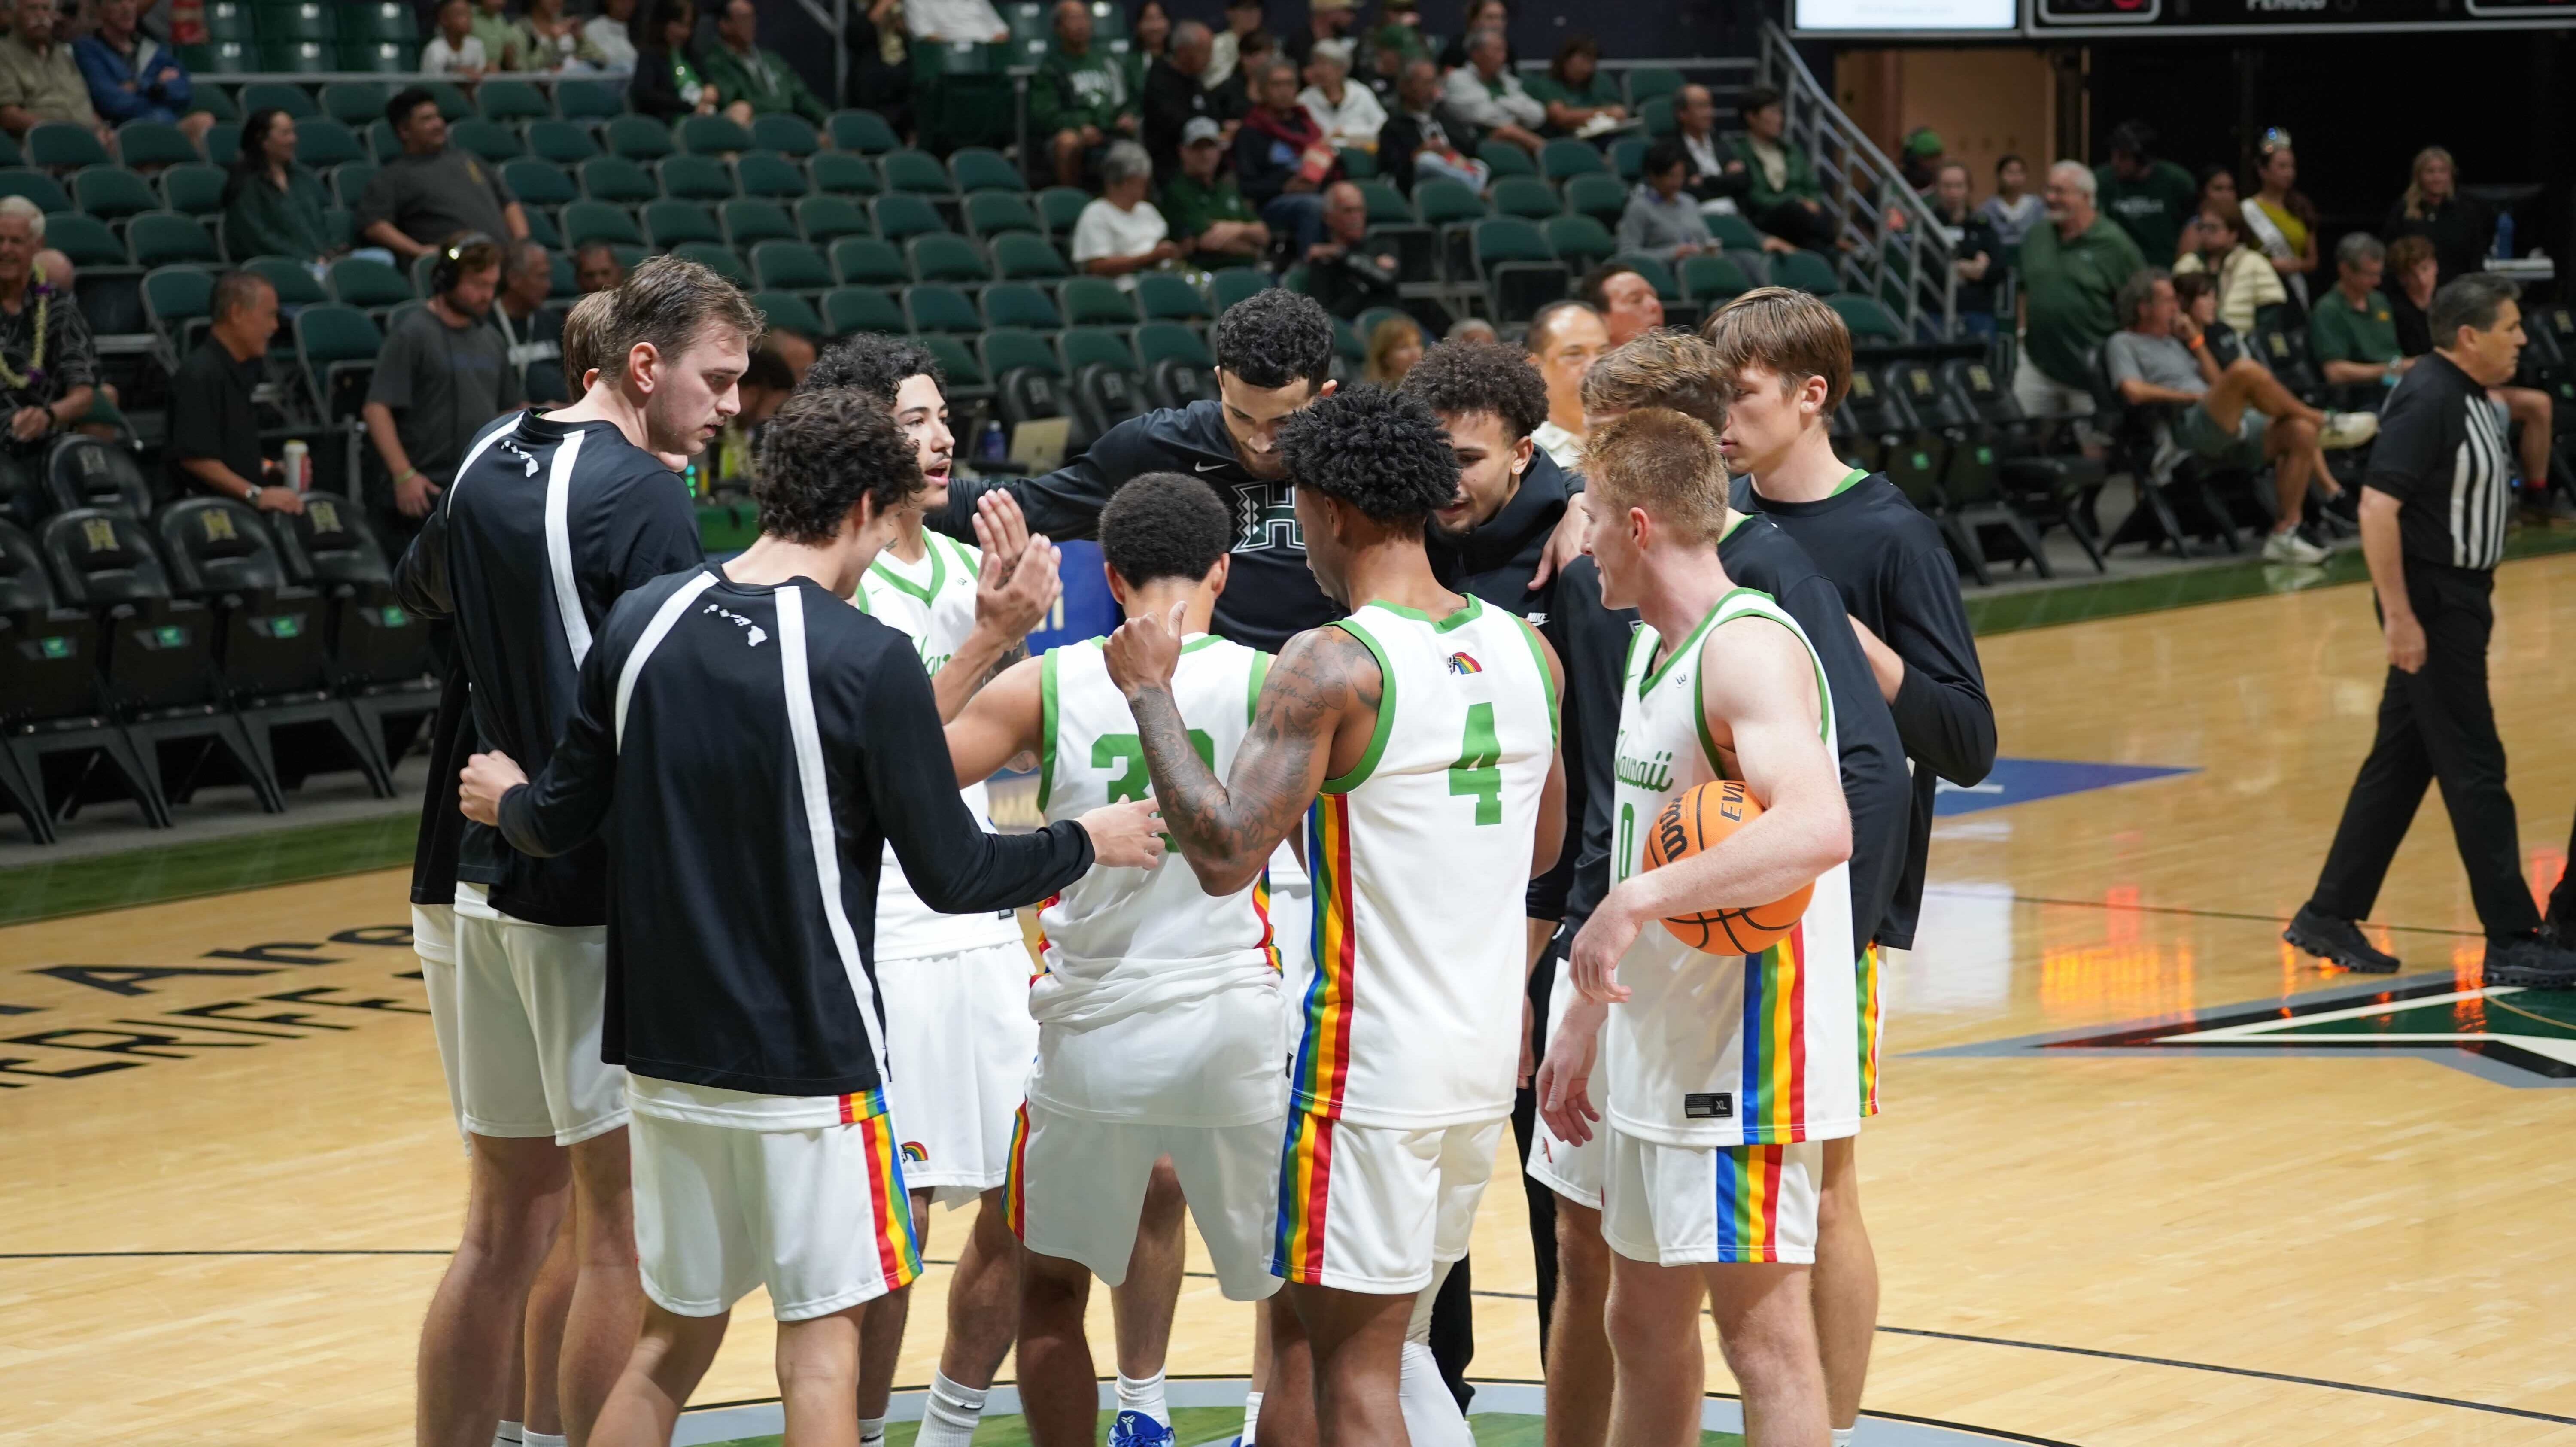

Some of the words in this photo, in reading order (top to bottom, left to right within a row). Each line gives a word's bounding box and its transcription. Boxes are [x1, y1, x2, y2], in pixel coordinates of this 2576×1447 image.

[1526, 612, 1548, 623] NIKE
[1449, 702, 1502, 826] 4
[1715, 1100, 1728, 1110] XL
